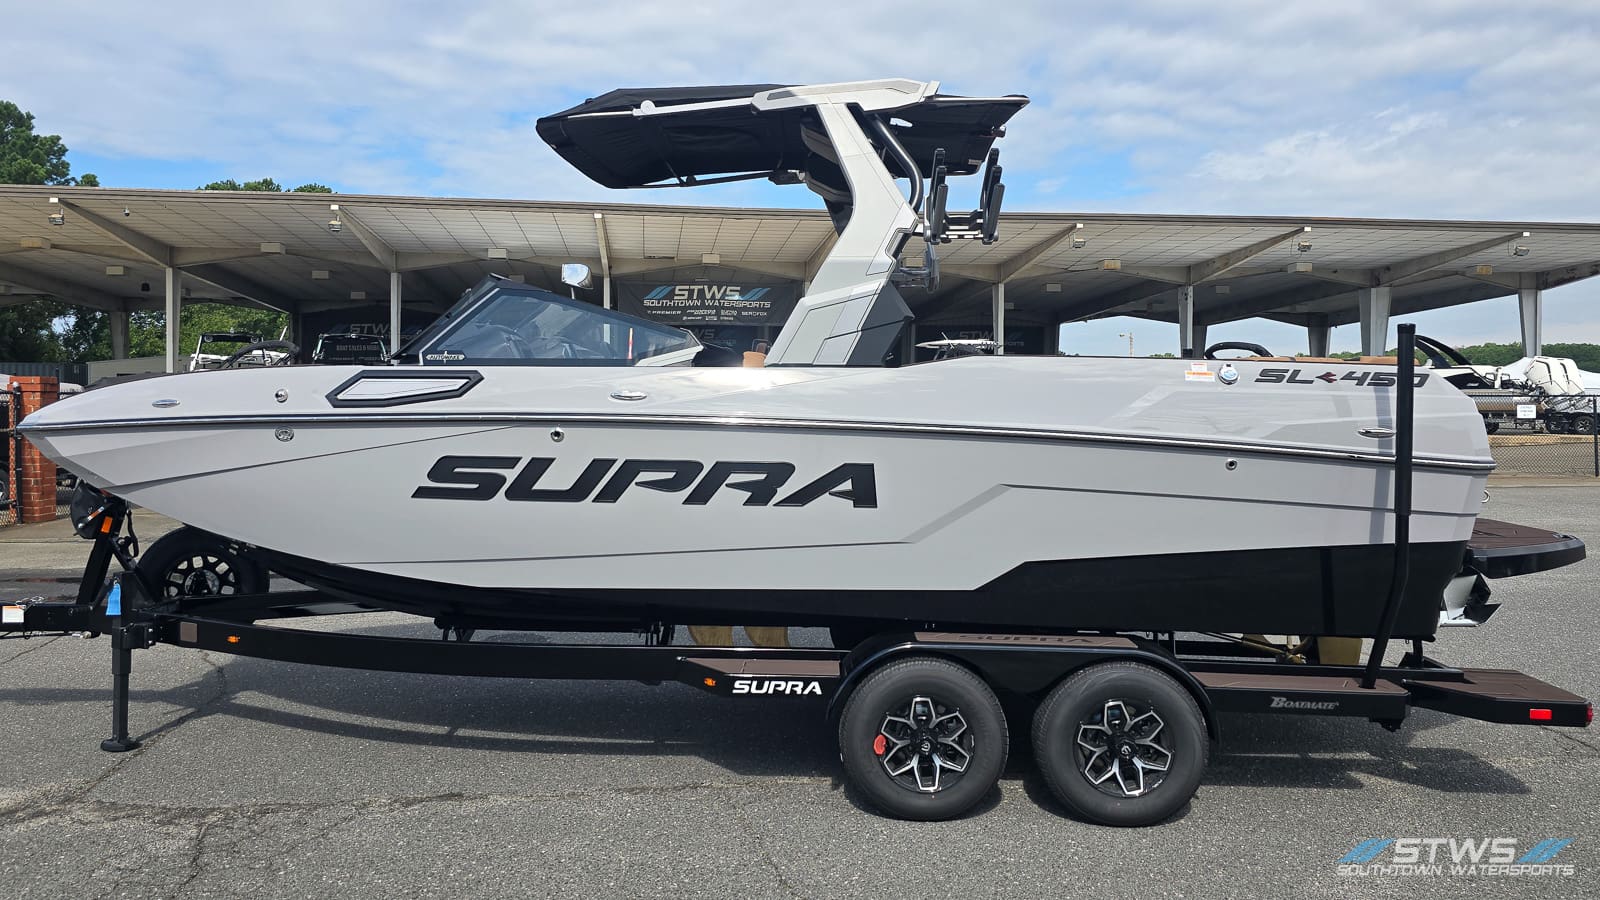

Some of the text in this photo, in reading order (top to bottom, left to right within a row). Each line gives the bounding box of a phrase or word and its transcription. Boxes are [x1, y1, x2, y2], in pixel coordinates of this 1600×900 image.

[674, 285, 741, 300] STWS
[705, 299, 771, 308] WATERSPORTS
[350, 323, 391, 334] STW
[1254, 368, 1314, 385] SL
[410, 455, 878, 508] SUPRA
[732, 680, 822, 695] SUPRA
